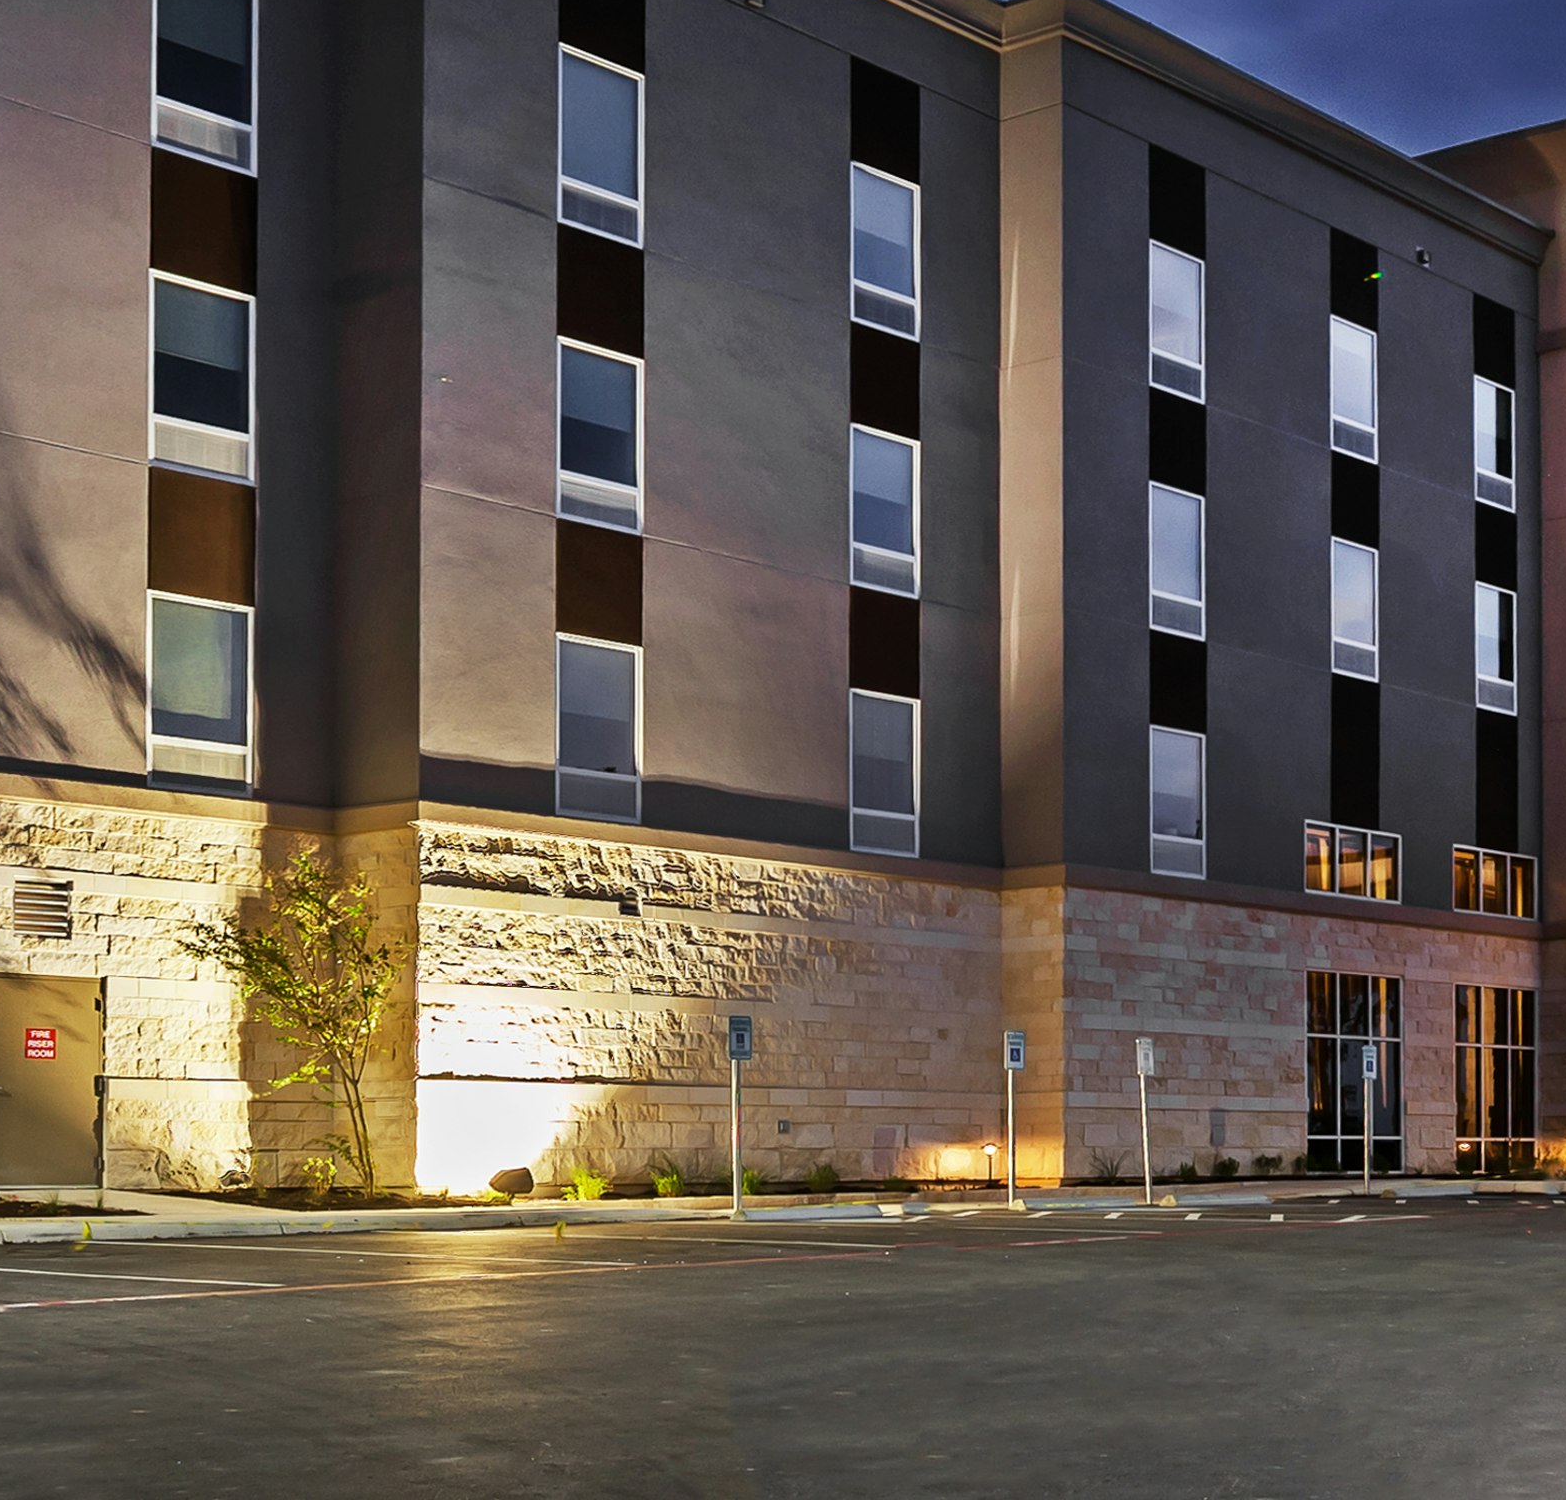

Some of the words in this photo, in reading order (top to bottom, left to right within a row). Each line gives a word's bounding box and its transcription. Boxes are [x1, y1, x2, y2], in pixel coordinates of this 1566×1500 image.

[30, 1030, 51, 1039] FIRE
[27, 1040, 54, 1048] RISER
[27, 1049, 54, 1057] ROOM
